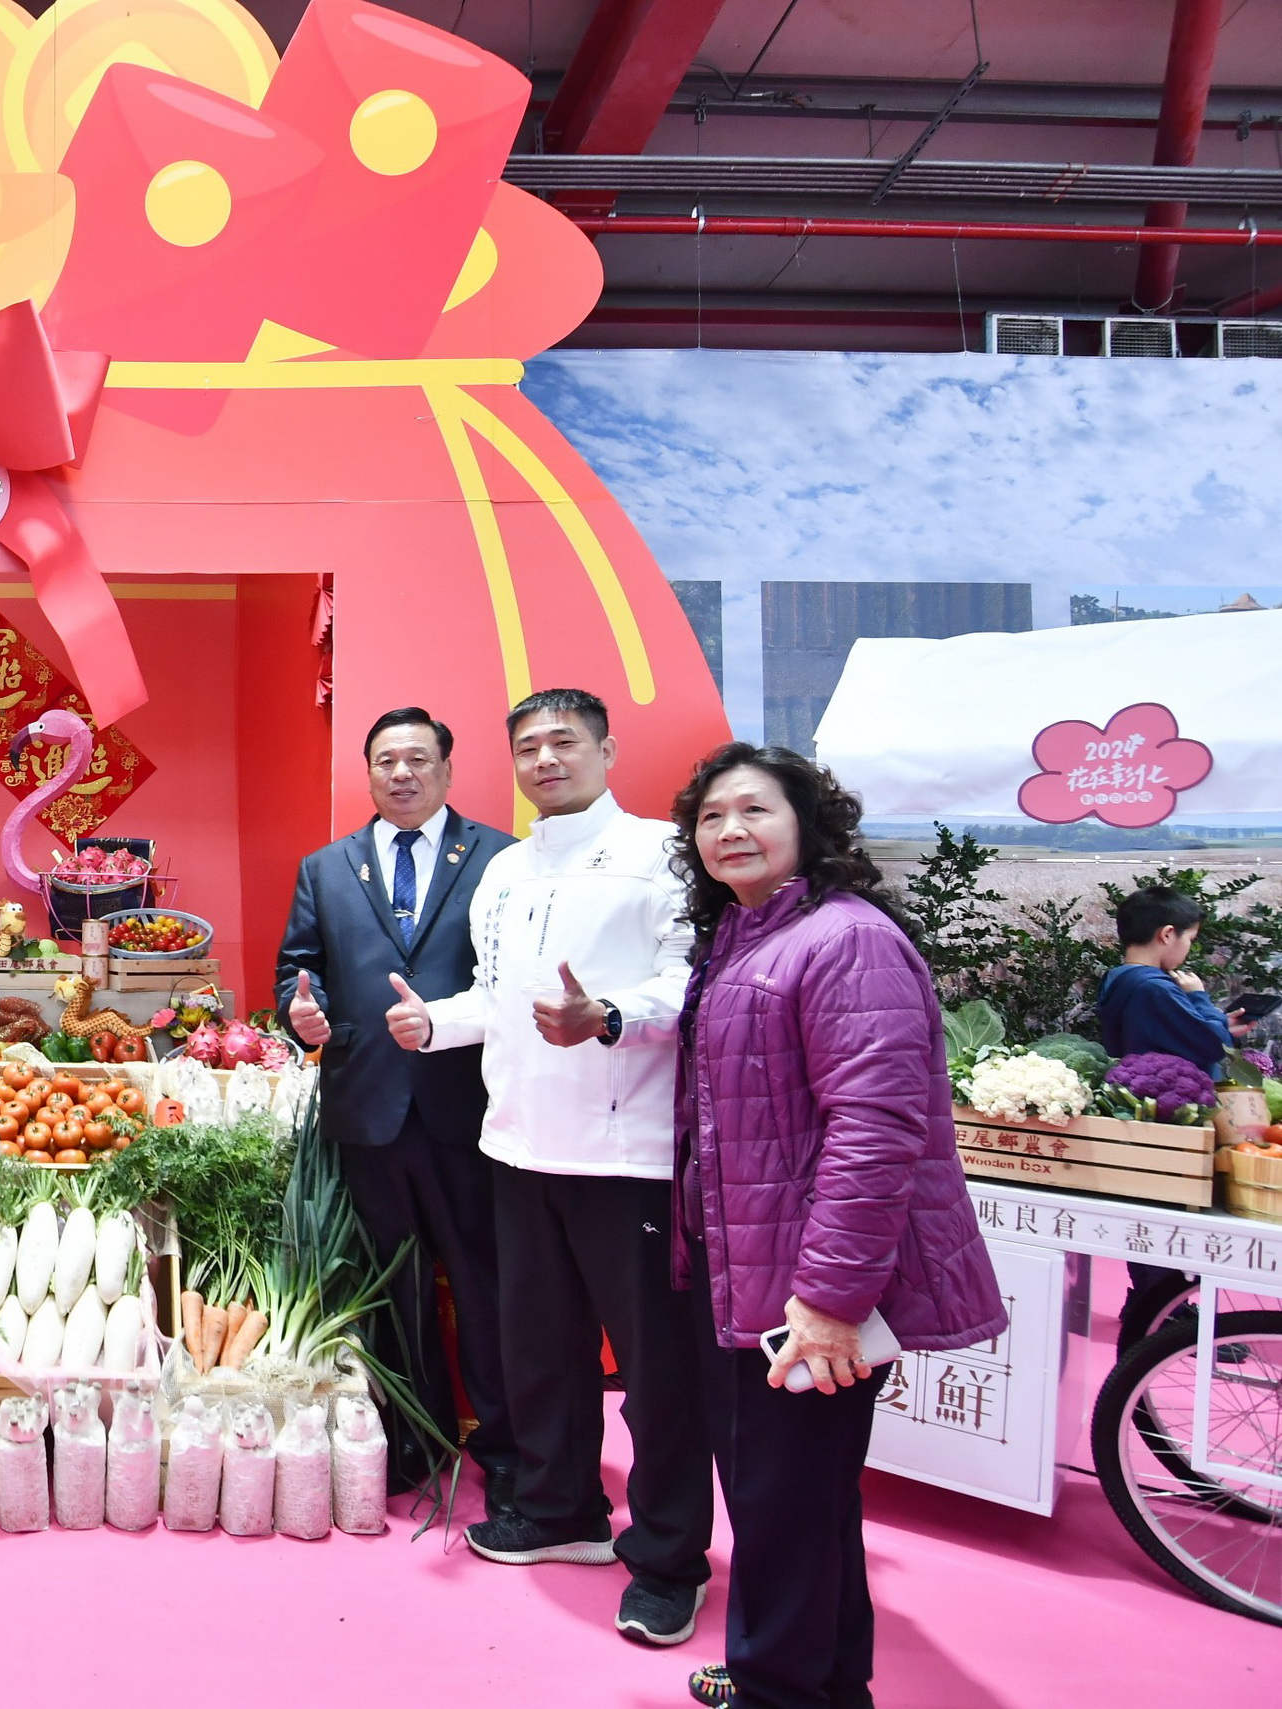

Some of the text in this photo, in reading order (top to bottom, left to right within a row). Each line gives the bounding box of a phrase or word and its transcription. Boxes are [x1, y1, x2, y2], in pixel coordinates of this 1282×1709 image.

[1085, 734, 1145, 761] 2024
[1067, 761, 1169, 792] 花在彰化
[963, 1155, 1052, 1174] Wooden box
[1126, 1222, 1277, 1272] 盡在彰化
